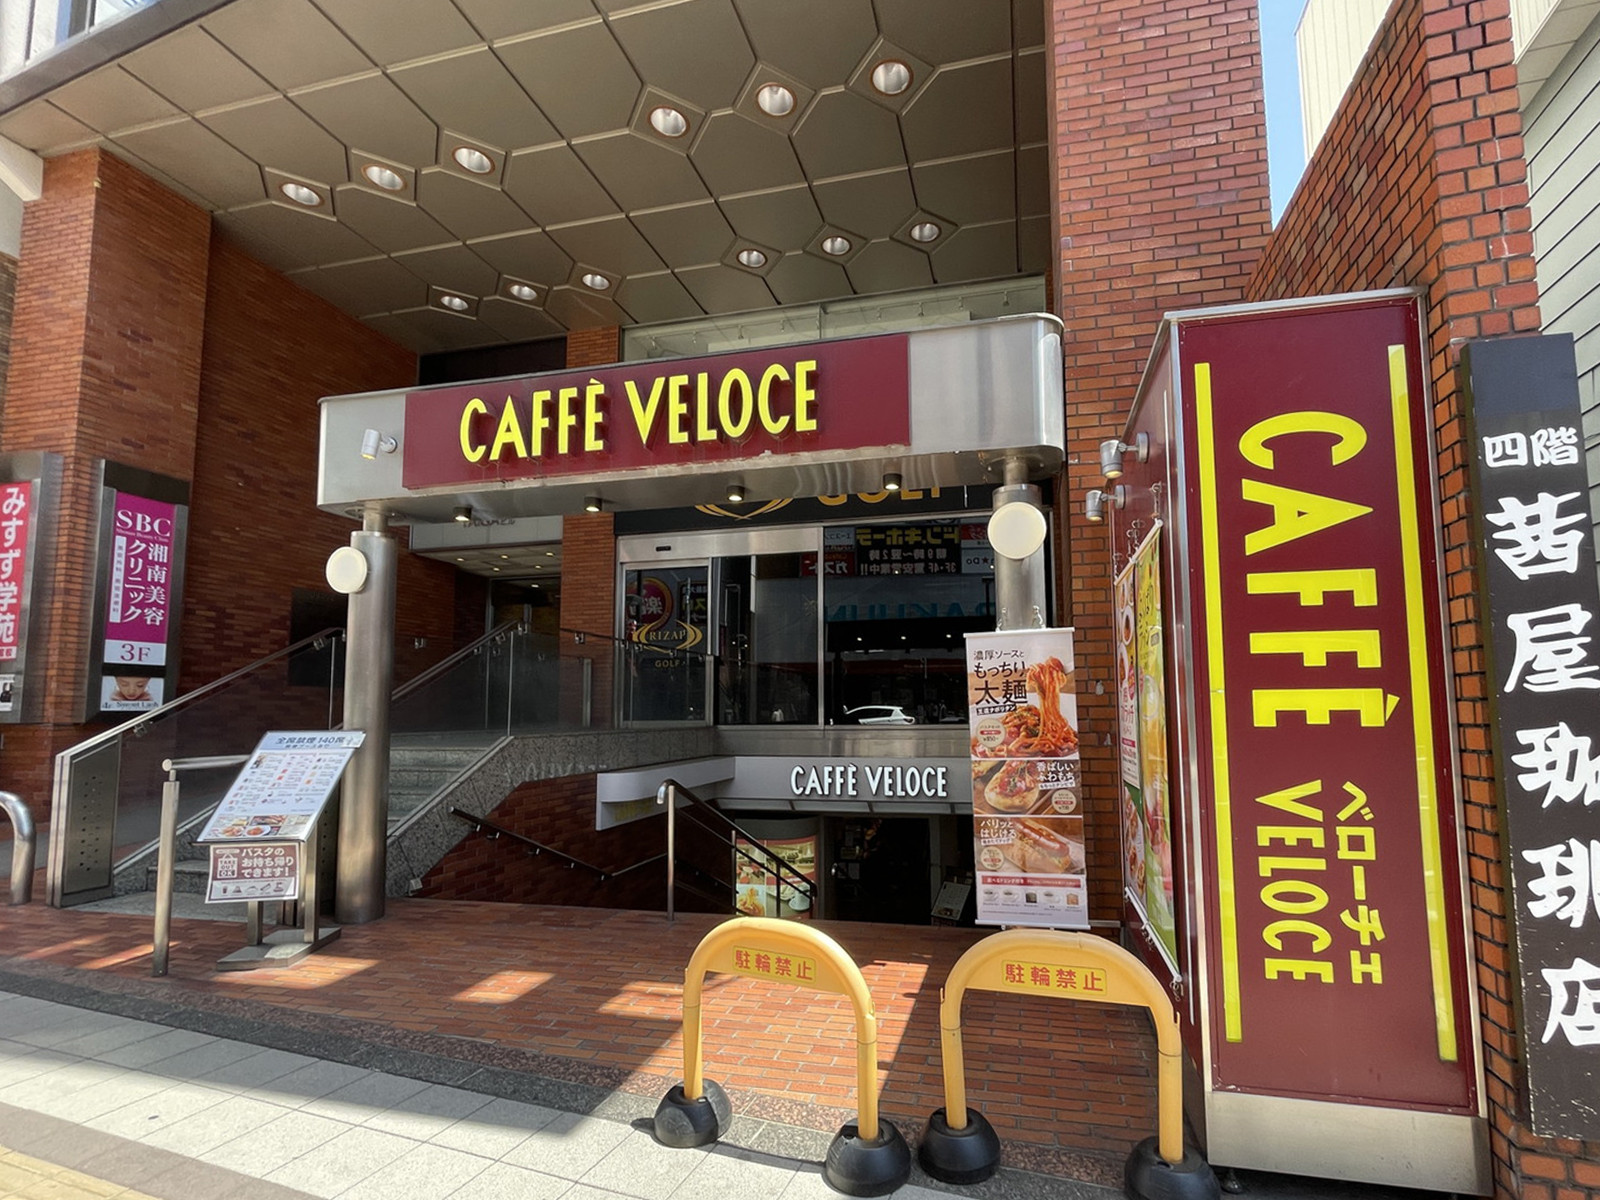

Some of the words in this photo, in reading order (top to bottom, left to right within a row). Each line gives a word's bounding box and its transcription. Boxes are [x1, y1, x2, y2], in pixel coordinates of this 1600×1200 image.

[460, 378, 605, 463] CAFFÈ
[624, 360, 817, 445] VELOCE
[1484, 428, 1579, 468] 四階
[116, 509, 171, 537] SBC
[123, 539, 147, 623] クリニック
[144, 543, 168, 626] 湘南美容
[1239, 411, 1400, 727] CAFFÈ
[120, 643, 151, 662] 3F
[649, 629, 686, 641] RIZAP
[974, 661, 1026, 678] もっちり
[974, 679, 1028, 706] 太麺
[790, 763, 858, 797] CAFFÈ
[865, 764, 948, 798] VELOCE
[1255, 779, 1334, 983] VELOCE
[1336, 781, 1386, 984] ベローチェ
[735, 948, 814, 982] 駐輪禁止
[1004, 963, 1105, 993] 駐輪禁止
